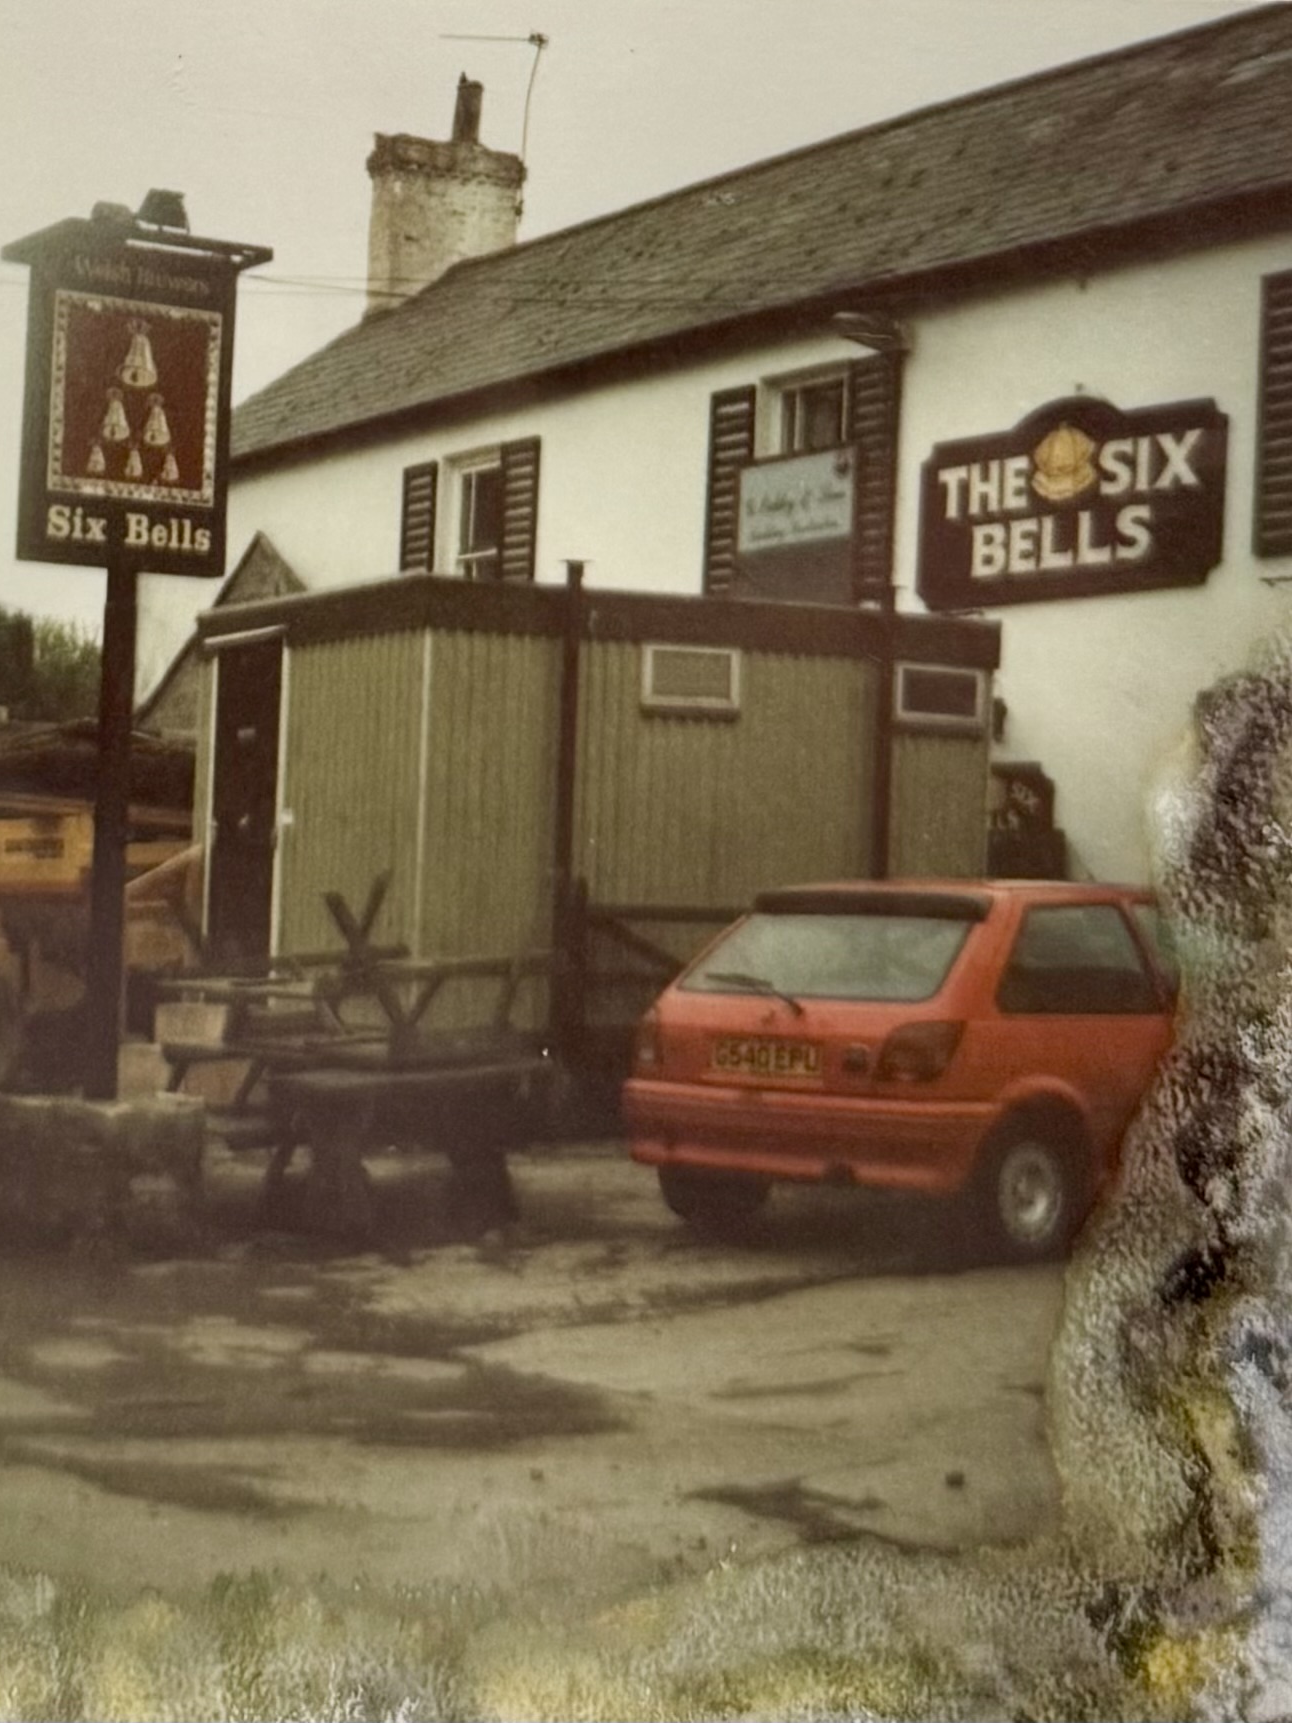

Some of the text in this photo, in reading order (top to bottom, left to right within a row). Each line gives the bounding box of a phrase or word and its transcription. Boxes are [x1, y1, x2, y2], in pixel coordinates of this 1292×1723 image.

[938, 428, 1205, 521] THE SIX
[46, 504, 213, 552] Six Bells
[970, 504, 1151, 579] BELLS
